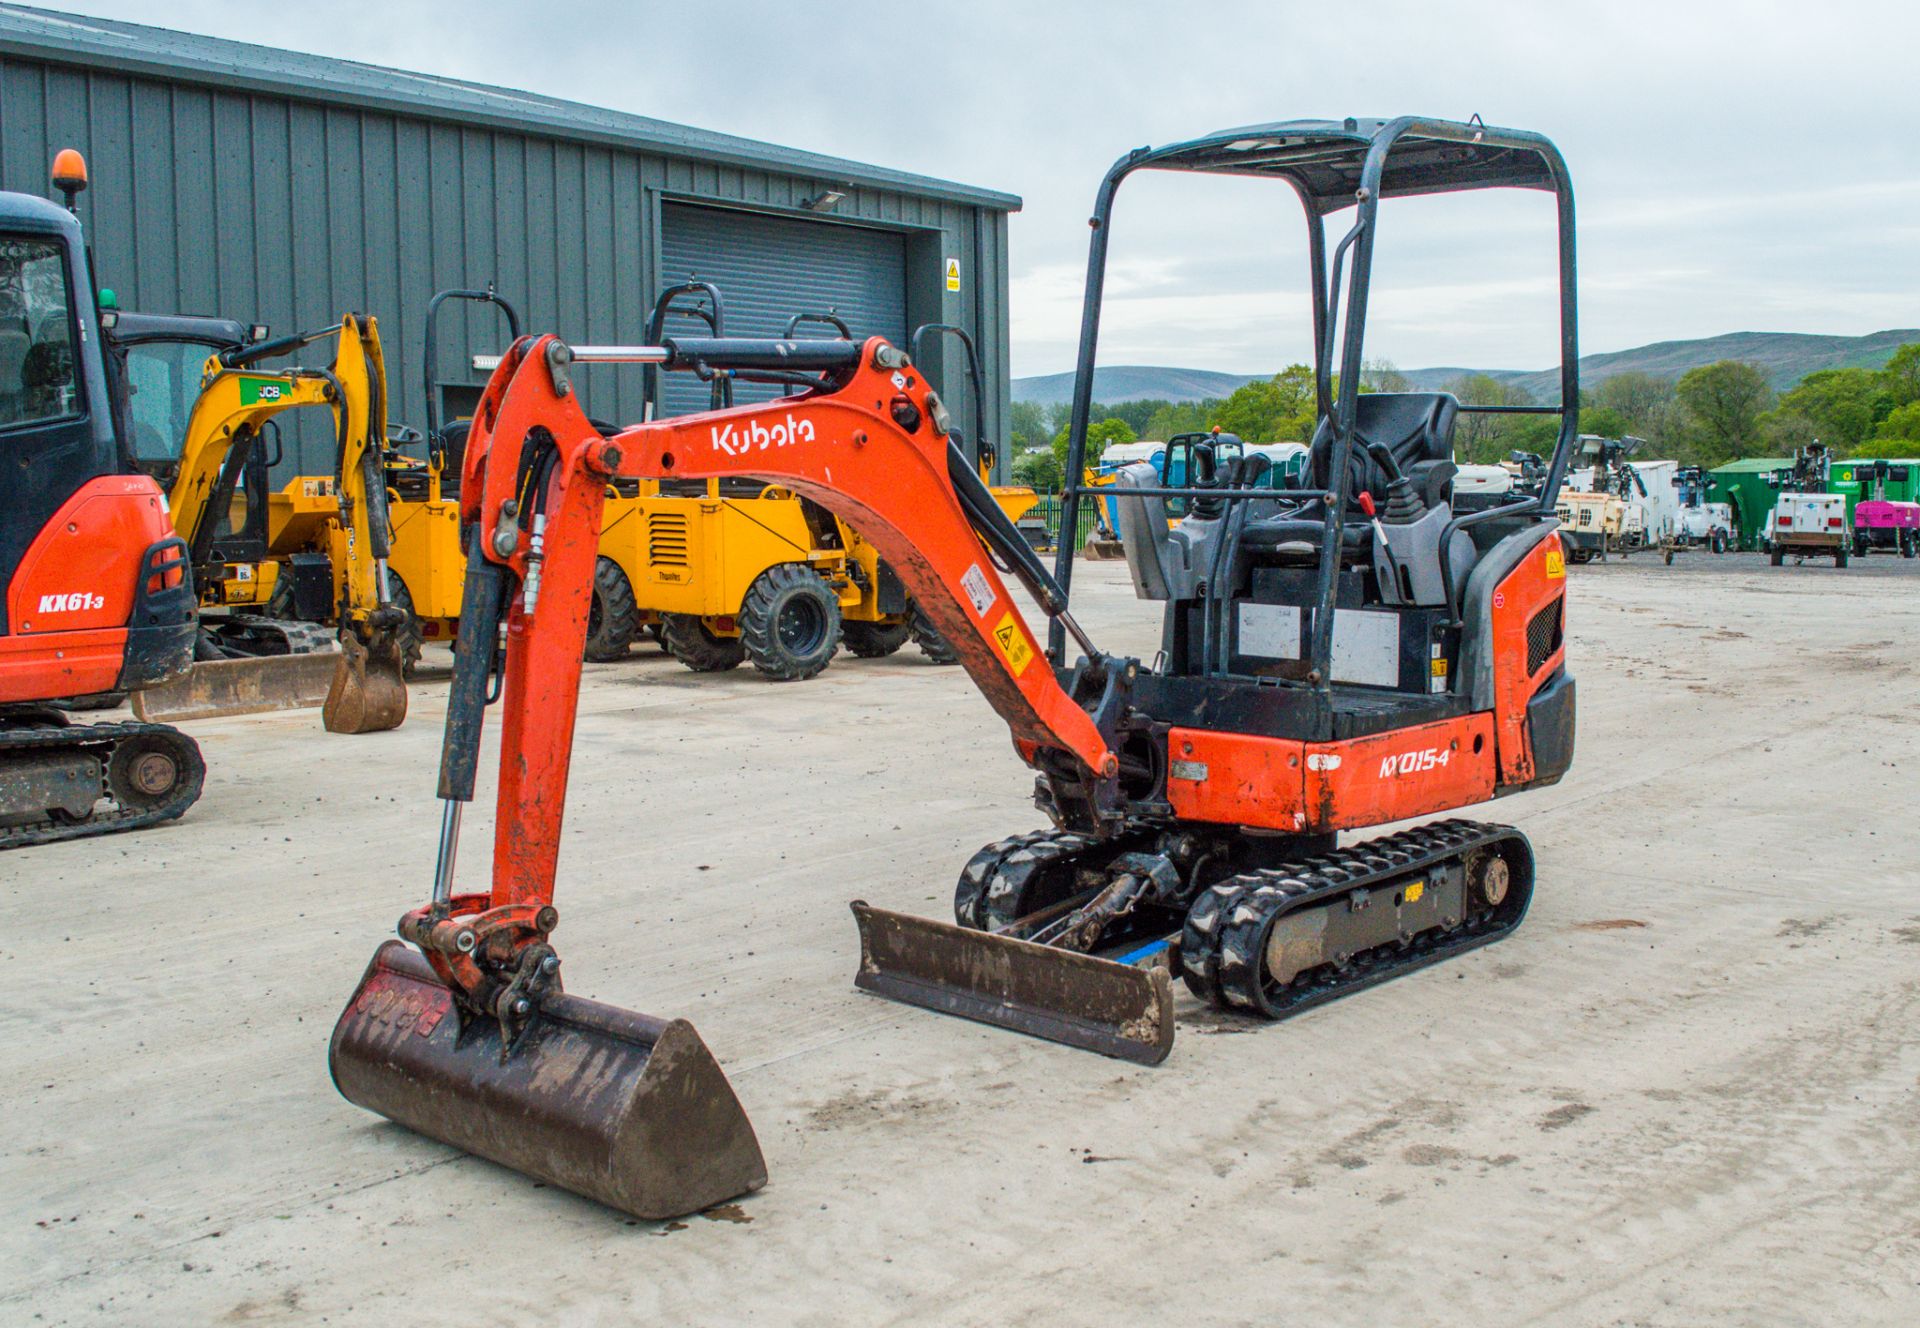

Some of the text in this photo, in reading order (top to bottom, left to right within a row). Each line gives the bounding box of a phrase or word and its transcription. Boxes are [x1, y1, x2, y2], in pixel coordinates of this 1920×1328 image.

[259, 385, 280, 398] JCB
[711, 414, 815, 456] Kubota
[38, 592, 105, 613] KX61-3
